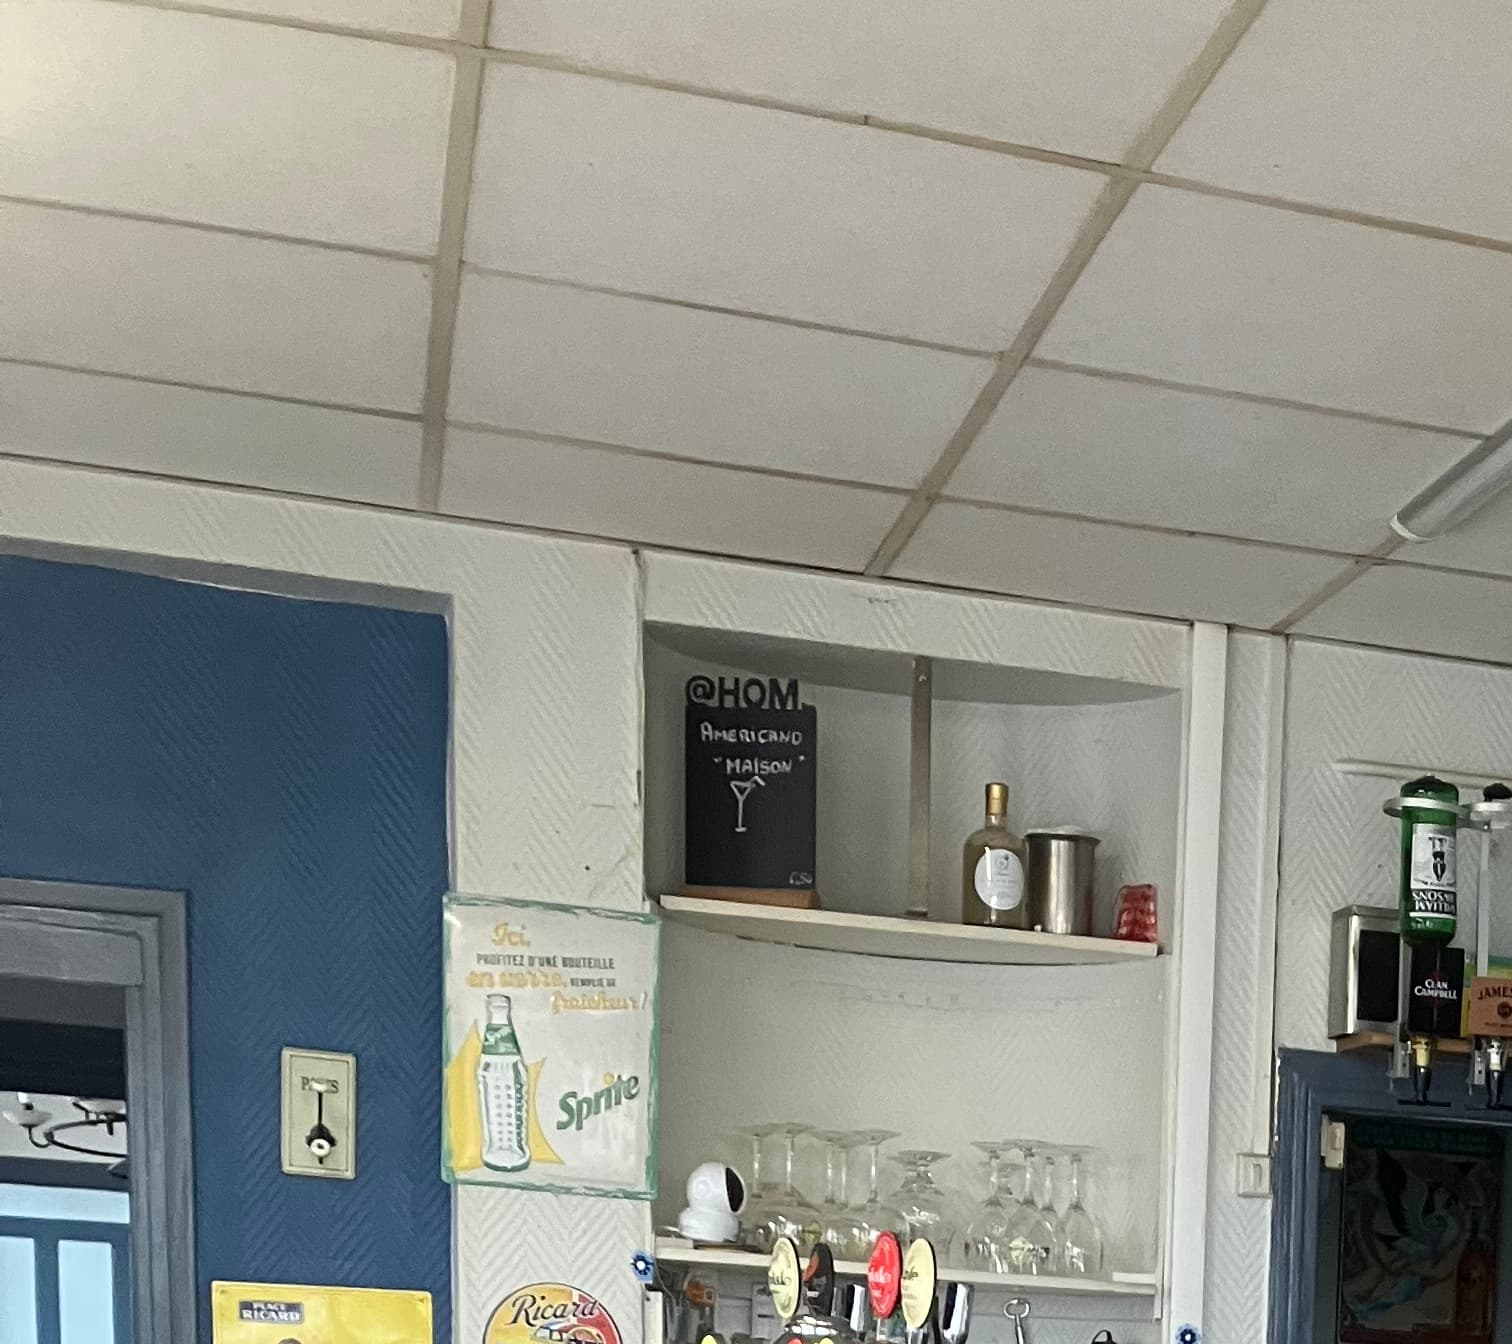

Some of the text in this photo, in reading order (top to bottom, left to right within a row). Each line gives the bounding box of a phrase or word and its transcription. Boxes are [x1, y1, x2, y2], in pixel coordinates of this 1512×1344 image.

[1424, 978, 1449, 990] CLAN
[1414, 985, 1458, 1000] CAMPBELL
[556, 1072, 641, 1131] Sprite
[241, 1309, 301, 1322] RICARD
[504, 1294, 600, 1328] Ricard
